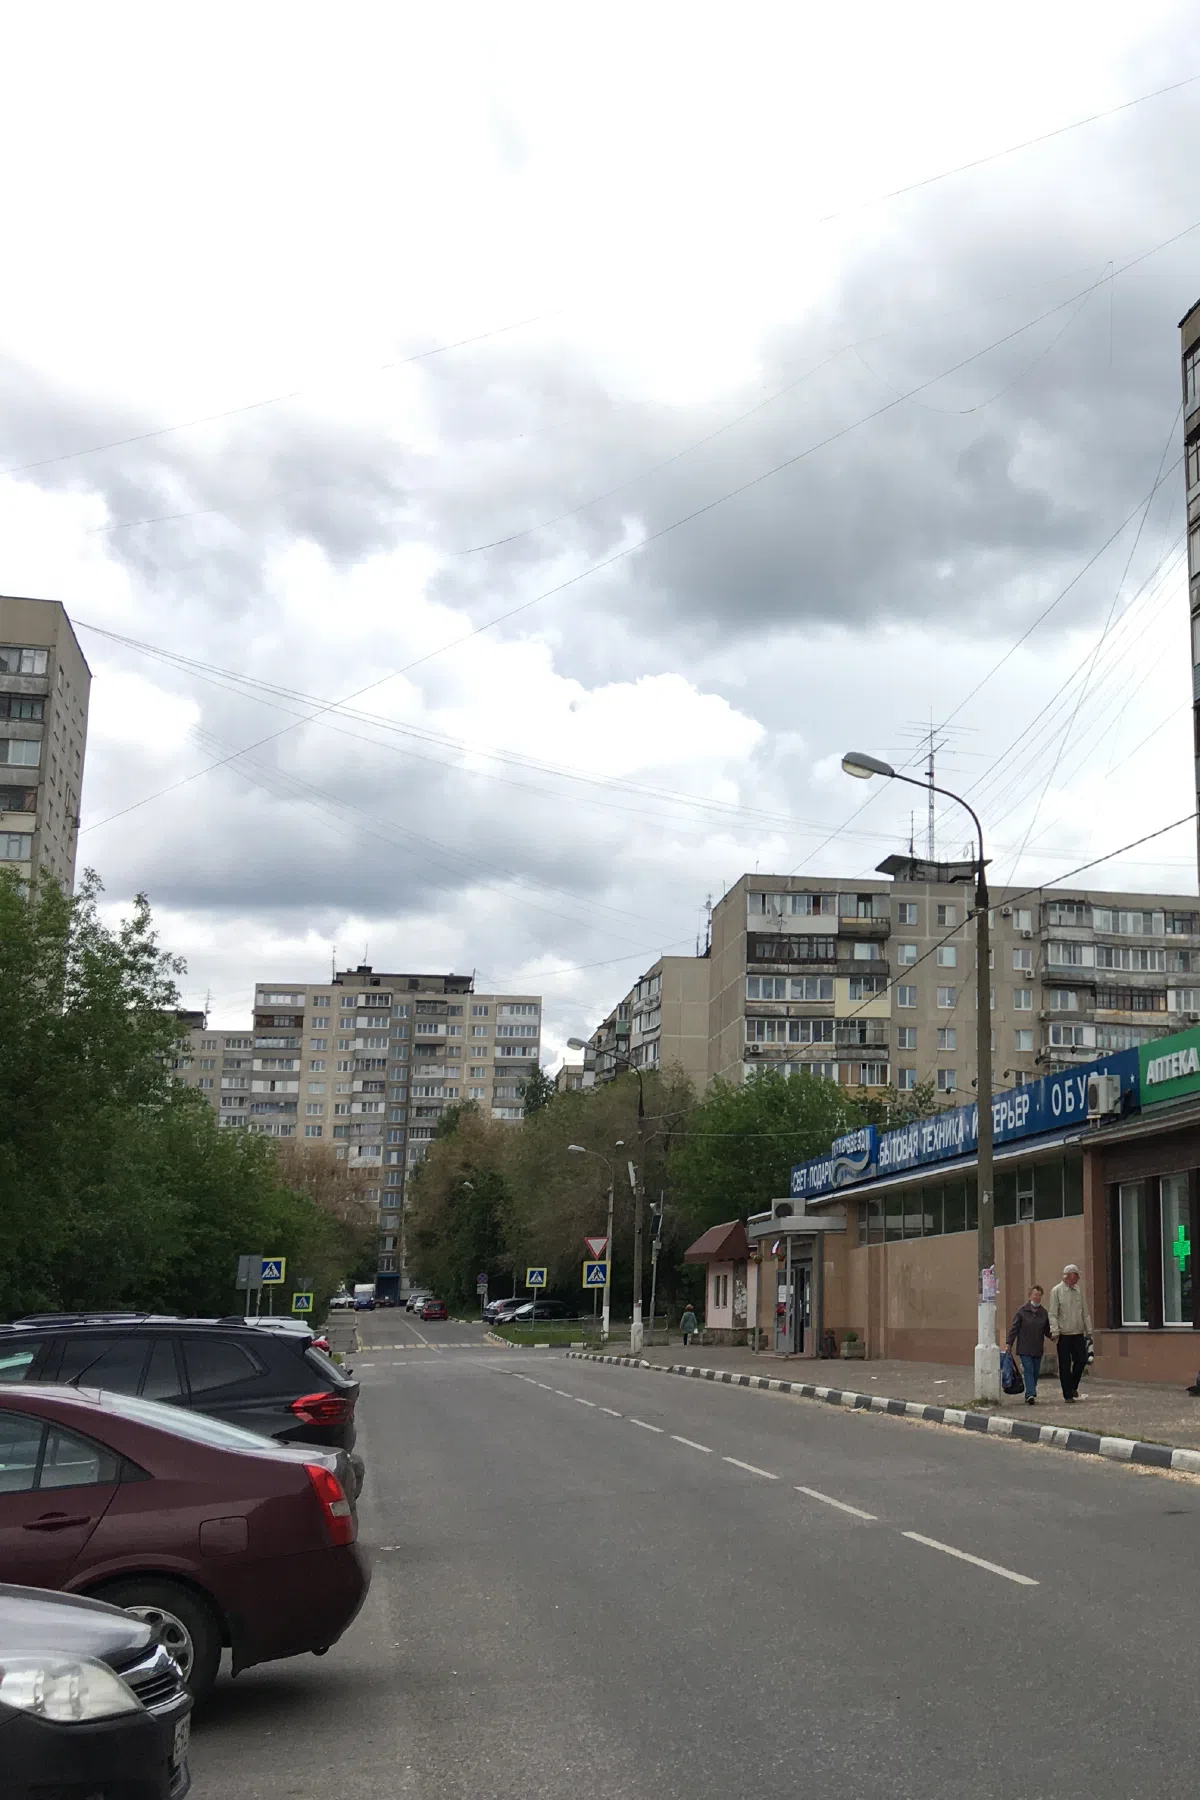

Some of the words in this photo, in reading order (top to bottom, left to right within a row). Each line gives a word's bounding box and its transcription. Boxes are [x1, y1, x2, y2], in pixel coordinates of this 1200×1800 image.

[1146, 1047, 1200, 1085] АПТЕКА
[879, 1130, 919, 1167] БЫТОВАЯ
[922, 1115, 965, 1154] ТЕХНИКА
[972, 1093, 1030, 1140] ИЕРЬЕР
[1051, 1067, 1108, 1117] ОБУ
[793, 1168, 807, 1192] СВЕТ
[809, 1160, 834, 1190] ПОДАРК
